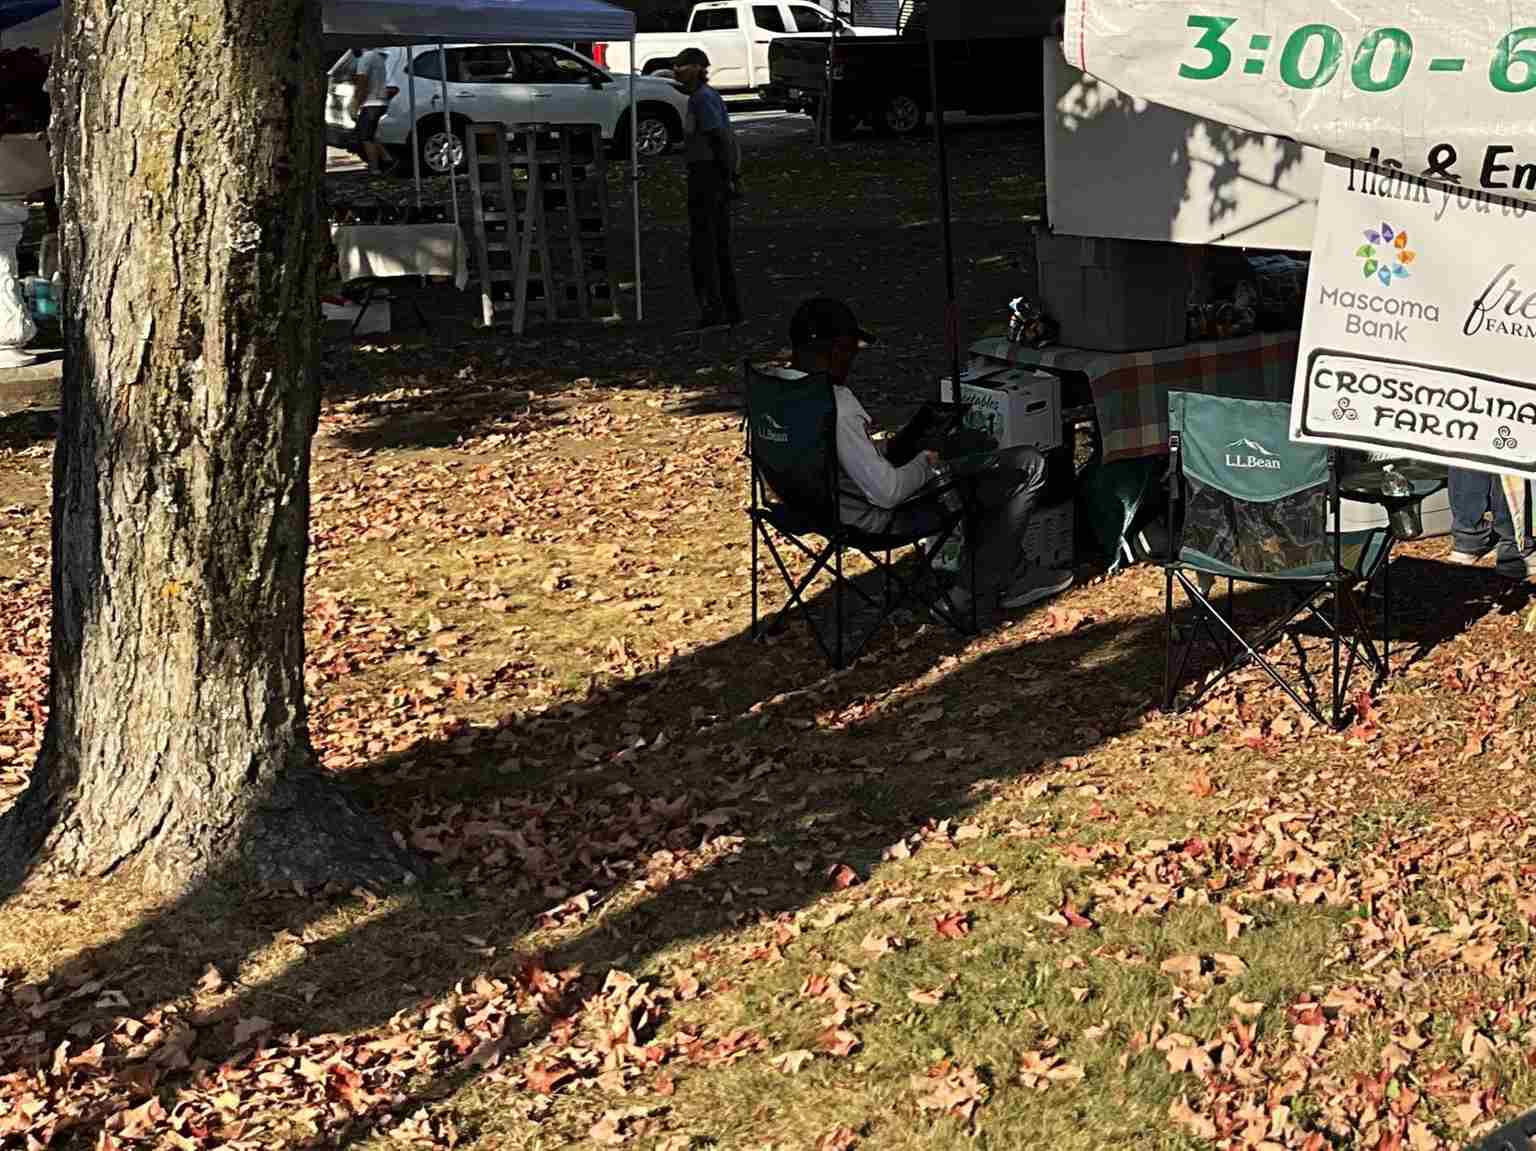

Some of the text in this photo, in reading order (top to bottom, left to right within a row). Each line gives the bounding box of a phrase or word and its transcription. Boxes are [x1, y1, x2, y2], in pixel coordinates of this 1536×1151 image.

[1178, 14, 1414, 93] 3:00
[1421, 144, 1461, 184] &
[1320, 286, 1440, 323] Mascoma
[1346, 314, 1408, 343] Bank
